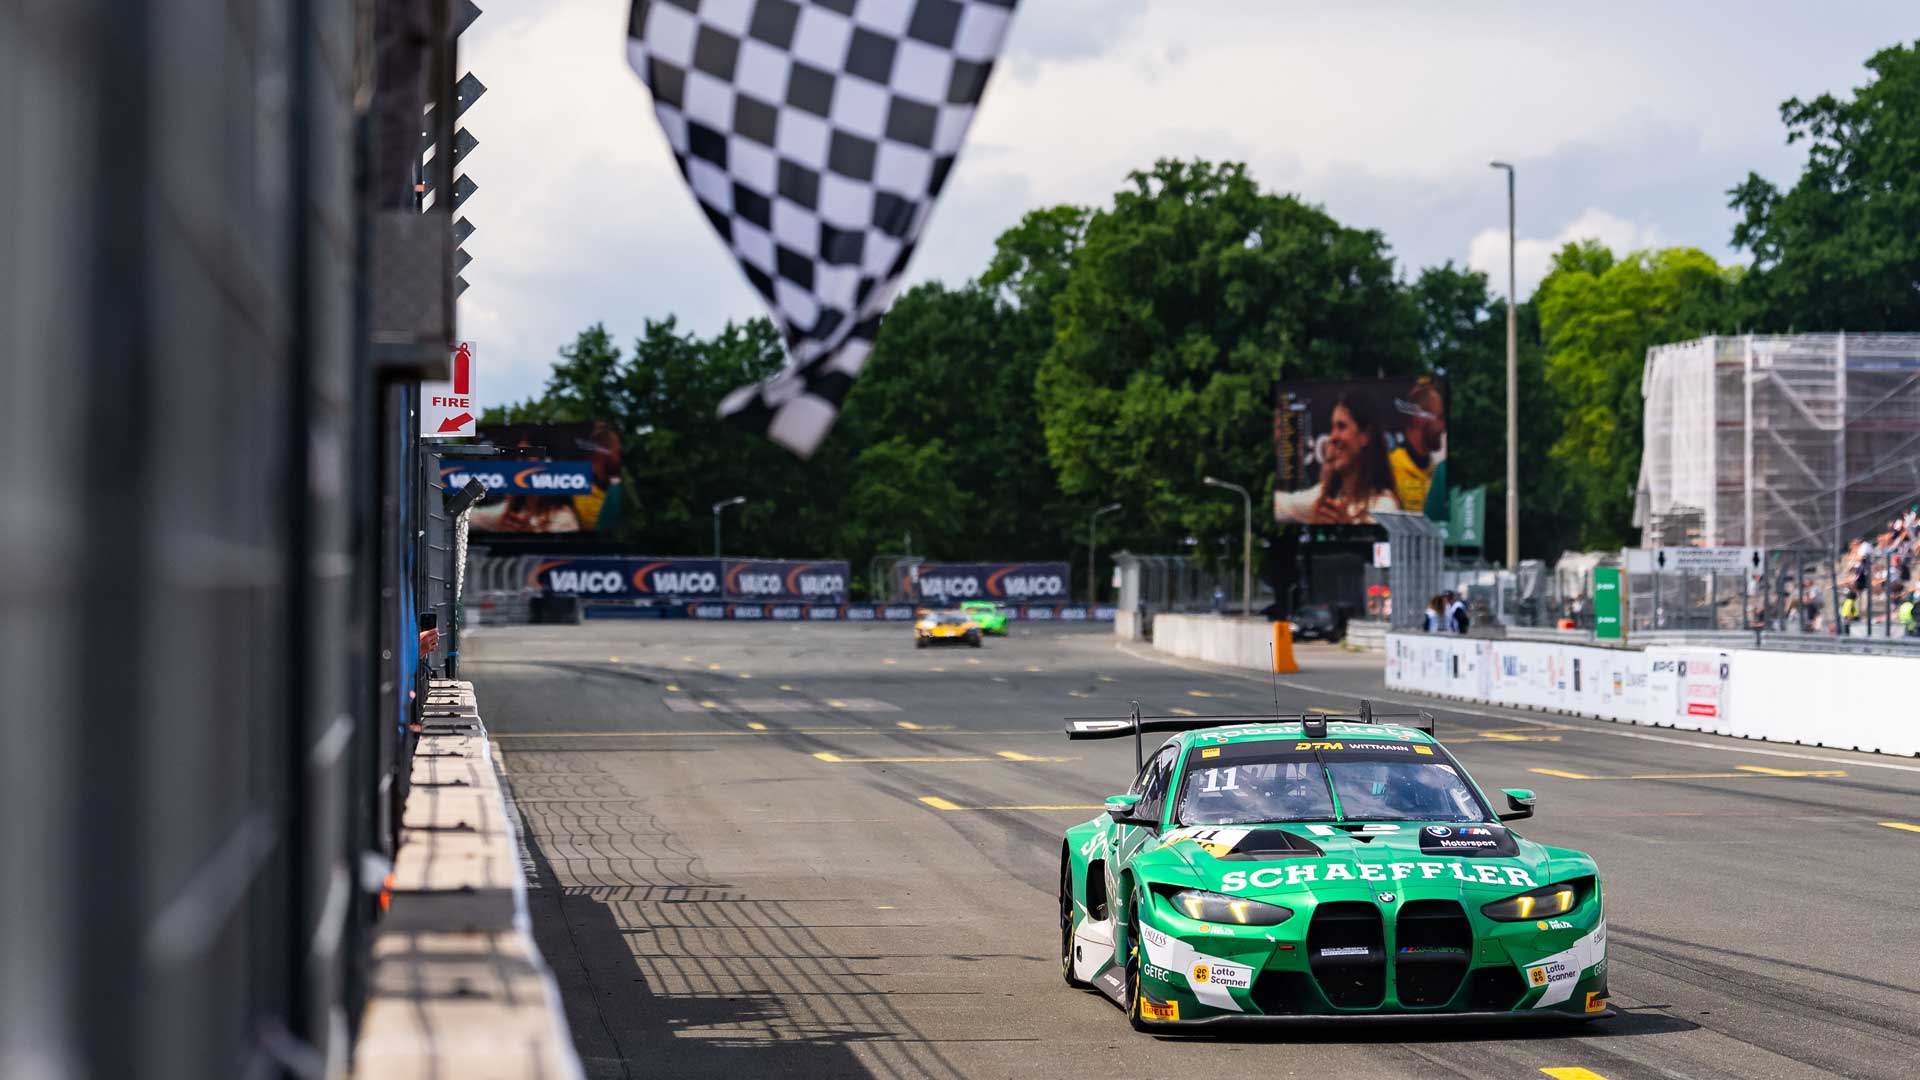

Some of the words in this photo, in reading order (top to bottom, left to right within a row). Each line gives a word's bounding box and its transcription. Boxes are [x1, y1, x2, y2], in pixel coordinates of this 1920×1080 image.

[432, 397, 469, 408] FIRE
[449, 473, 504, 489] VACO
[531, 473, 586, 489] VAICO
[550, 571, 622, 593] VAICO
[653, 572, 716, 593] VAICO
[920, 577, 978, 597] VAICO
[1004, 576, 1061, 596] VAICO
[1200, 725, 1421, 741] RoboMrkets
[1295, 742, 1345, 751] DTM
[1349, 743, 1409, 752] WITTMANN
[1202, 767, 1240, 793] 11
[1190, 830, 1220, 841] 11
[1440, 839, 1497, 848] Motorsport
[1221, 862, 1538, 892] SCHAEFFLER
[1144, 964, 1170, 982] GETEC
[1211, 966, 1236, 977] Lotto
[1545, 964, 1566, 974] Lotto
[1547, 970, 1576, 983] Scanner
[1210, 976, 1248, 987] Scanner
[1143, 1001, 1174, 1017] PIRELLI
